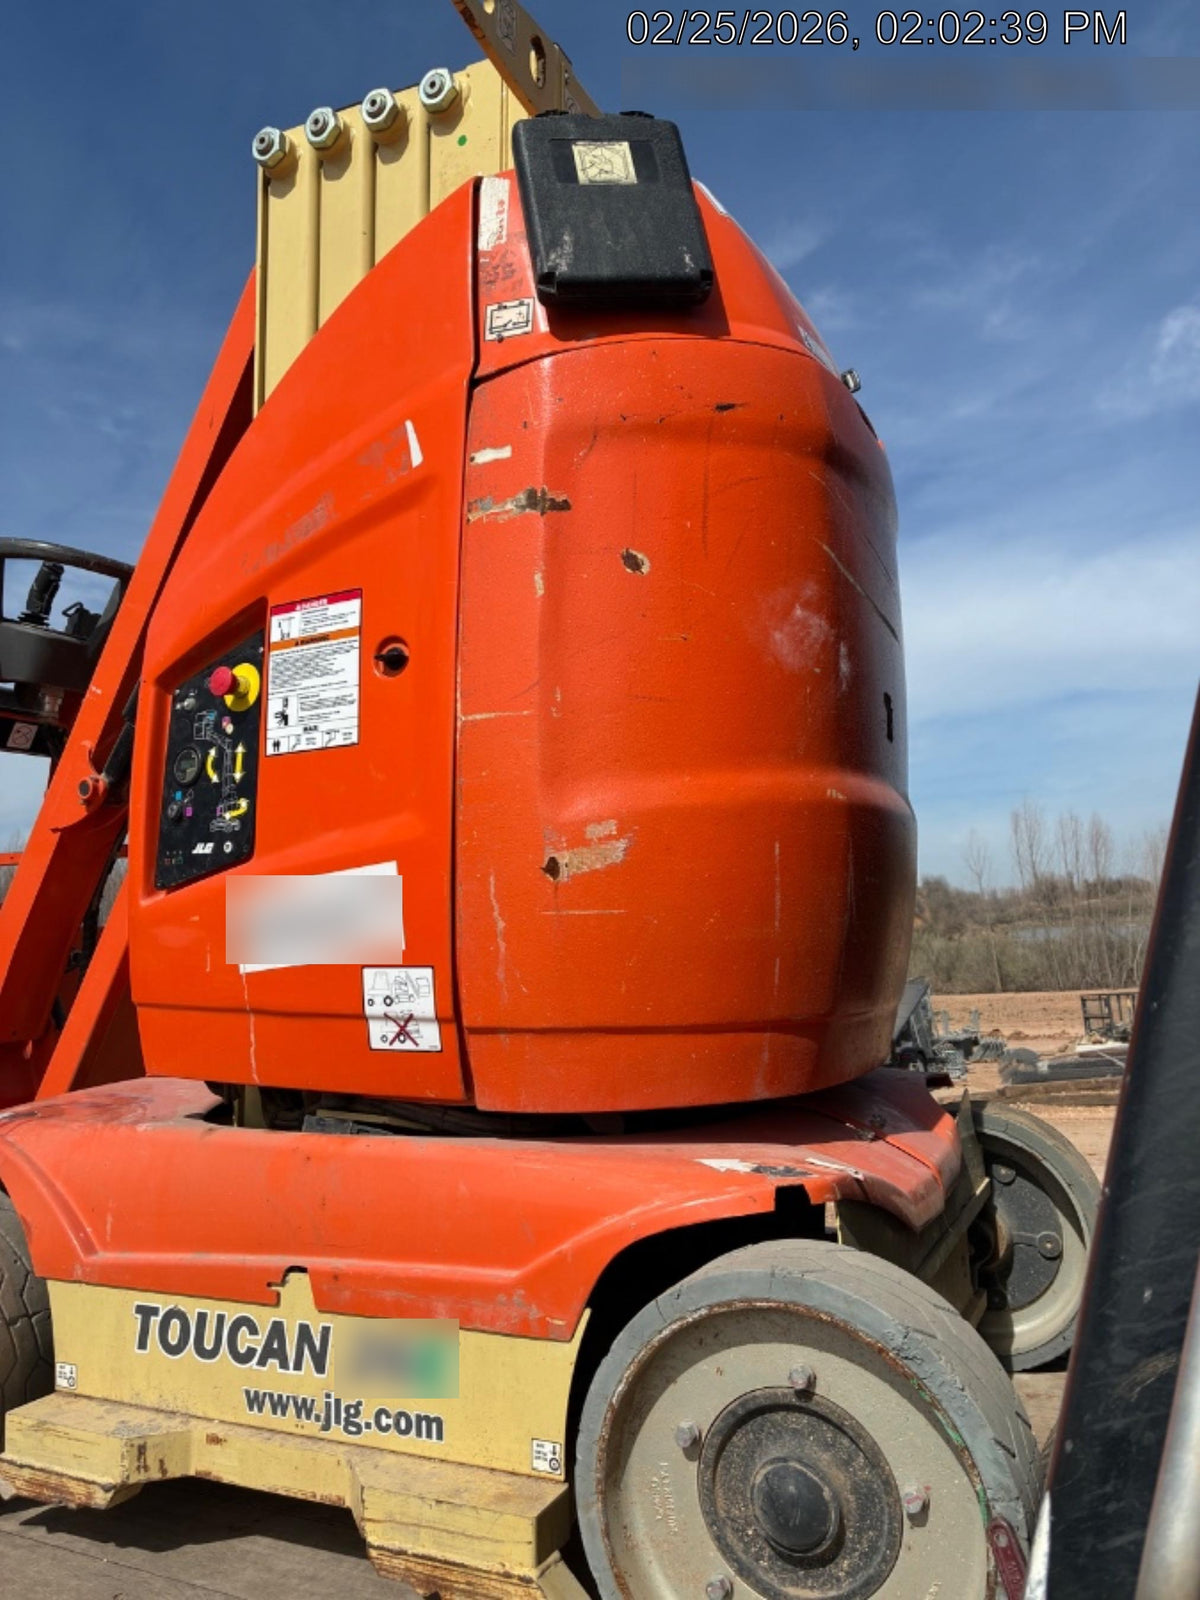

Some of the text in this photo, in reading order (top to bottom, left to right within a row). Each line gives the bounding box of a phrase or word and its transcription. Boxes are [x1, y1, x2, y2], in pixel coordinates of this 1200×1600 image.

[191, 842, 215, 854] JLG
[134, 1302, 333, 1377] TOUCAN
[243, 1391, 444, 1442] www.jlg.com
